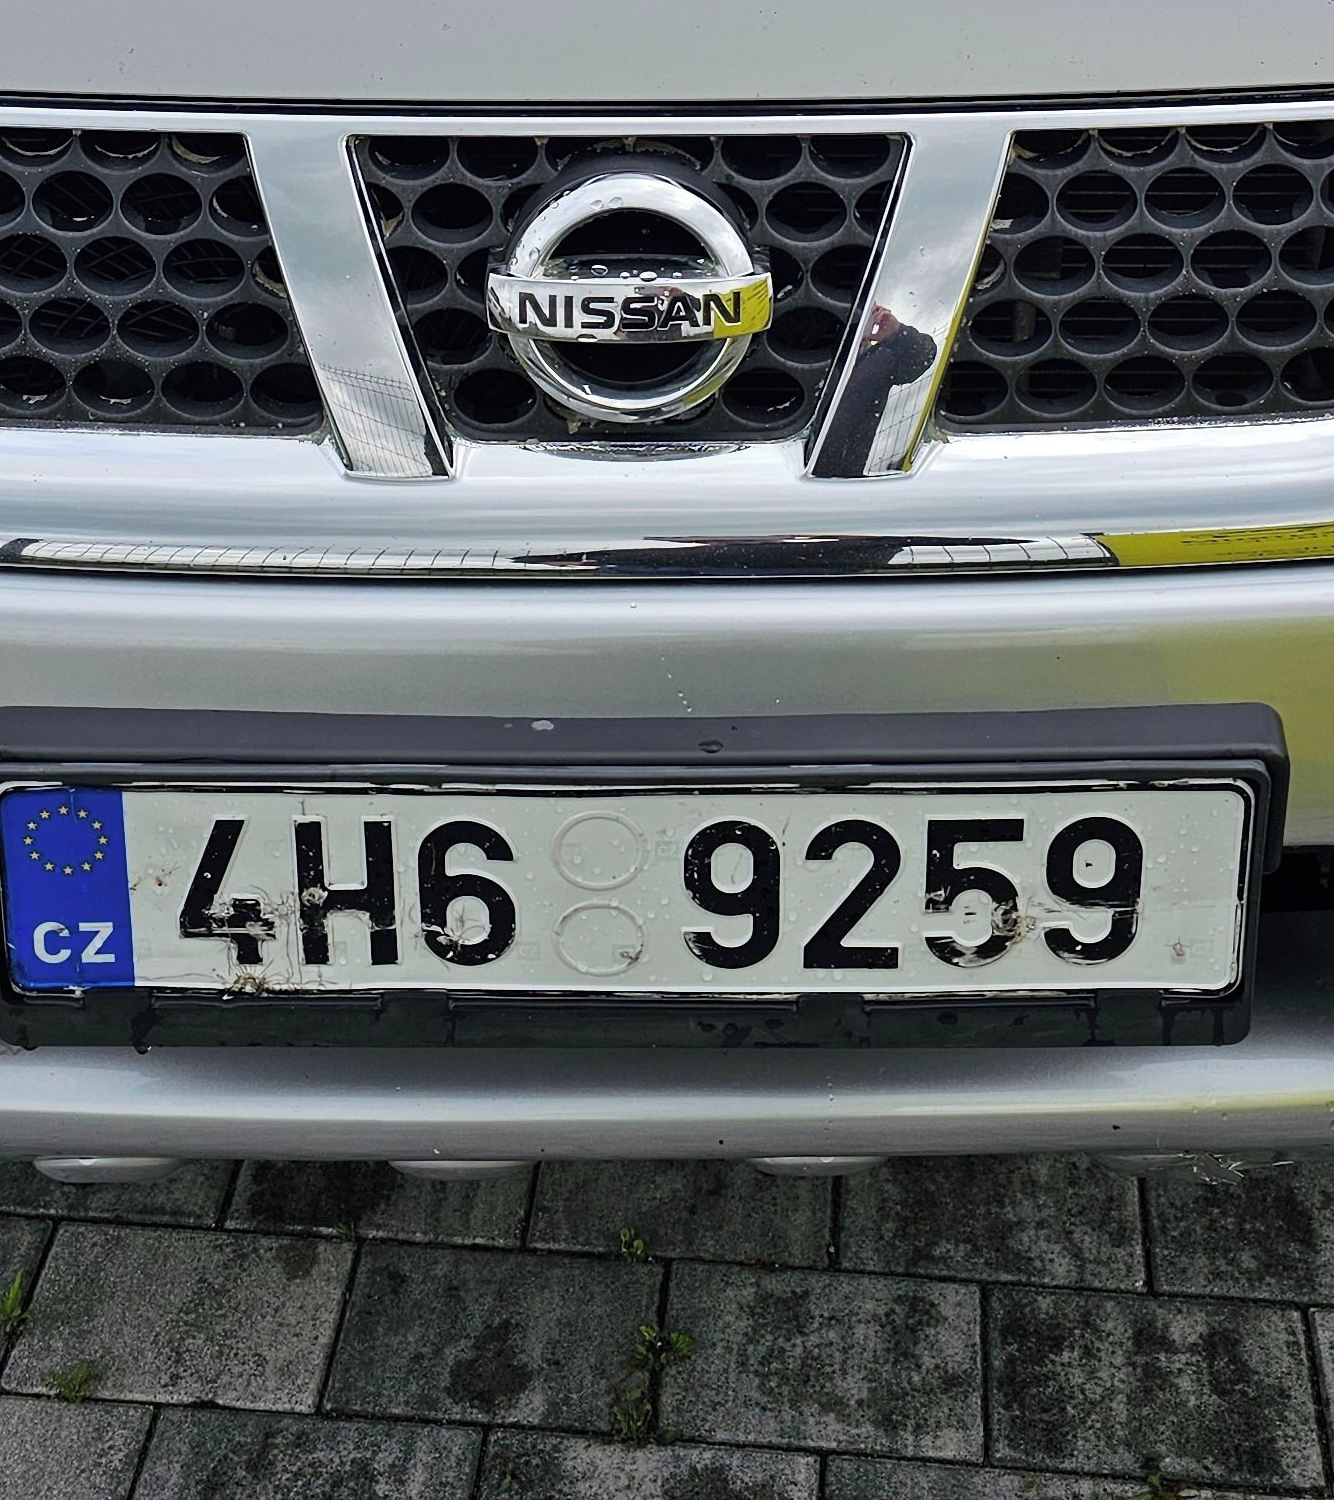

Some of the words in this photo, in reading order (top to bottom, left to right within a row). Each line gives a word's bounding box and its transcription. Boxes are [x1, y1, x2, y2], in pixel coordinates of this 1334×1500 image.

[518, 291, 741, 331] NISSAN
[180, 818, 516, 967] 4H6
[683, 816, 1143, 969] 9259
[32, 921, 115, 964] CZ
